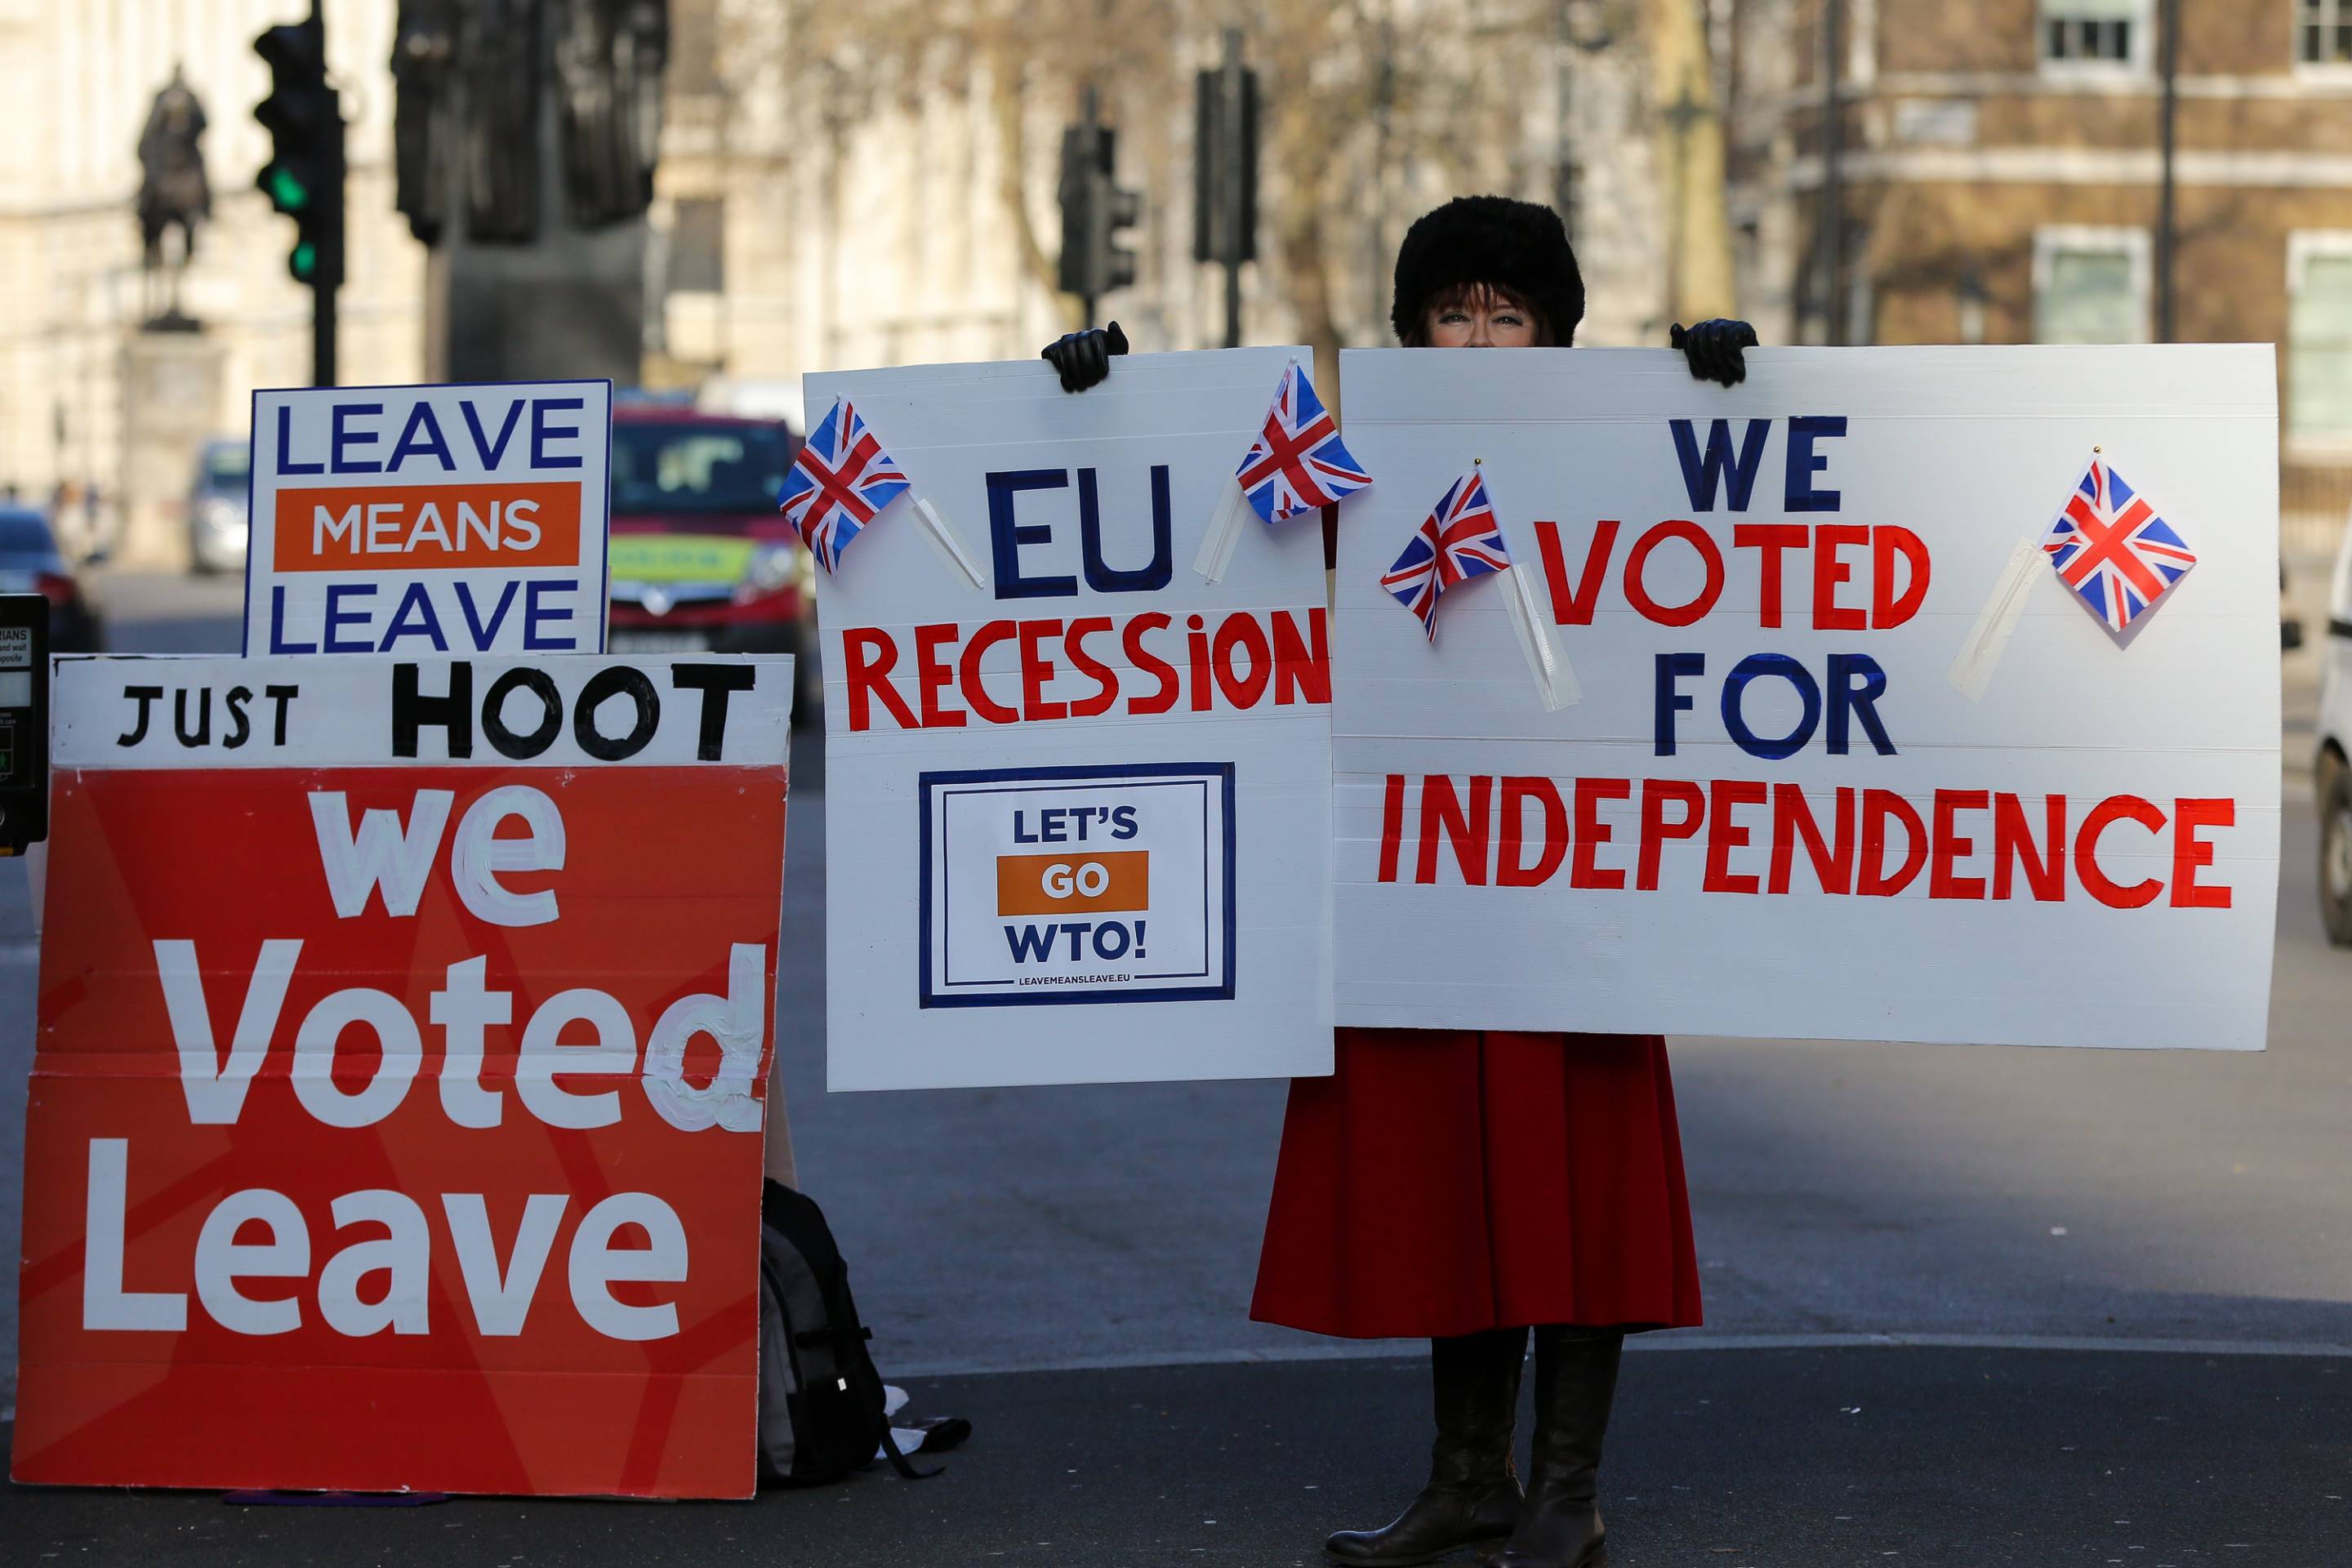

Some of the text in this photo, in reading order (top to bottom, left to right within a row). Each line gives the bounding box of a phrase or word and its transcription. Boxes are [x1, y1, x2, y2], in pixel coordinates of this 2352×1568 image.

[277, 398, 584, 475] LEAVE
[1668, 416, 1847, 512] WE
[312, 499, 541, 555] MEANS
[985, 464, 1173, 599] EU
[1534, 519, 1931, 631] VOTED
[270, 580, 578, 653] LEAVE
[116, 661, 756, 761] JUST HOOT
[1655, 653, 1898, 760] FOR
[307, 785, 567, 928] we
[1013, 805, 1138, 844] LET'S
[1377, 773, 2234, 909] INDEPENDENCE
[1041, 862, 1110, 899] GO
[1004, 920, 1147, 964] WTO!
[1018, 973, 1131, 987] LEAVEMEANSLEAVE.EU
[153, 938, 767, 1133] Voted
[83, 1138, 689, 1341] Leave
